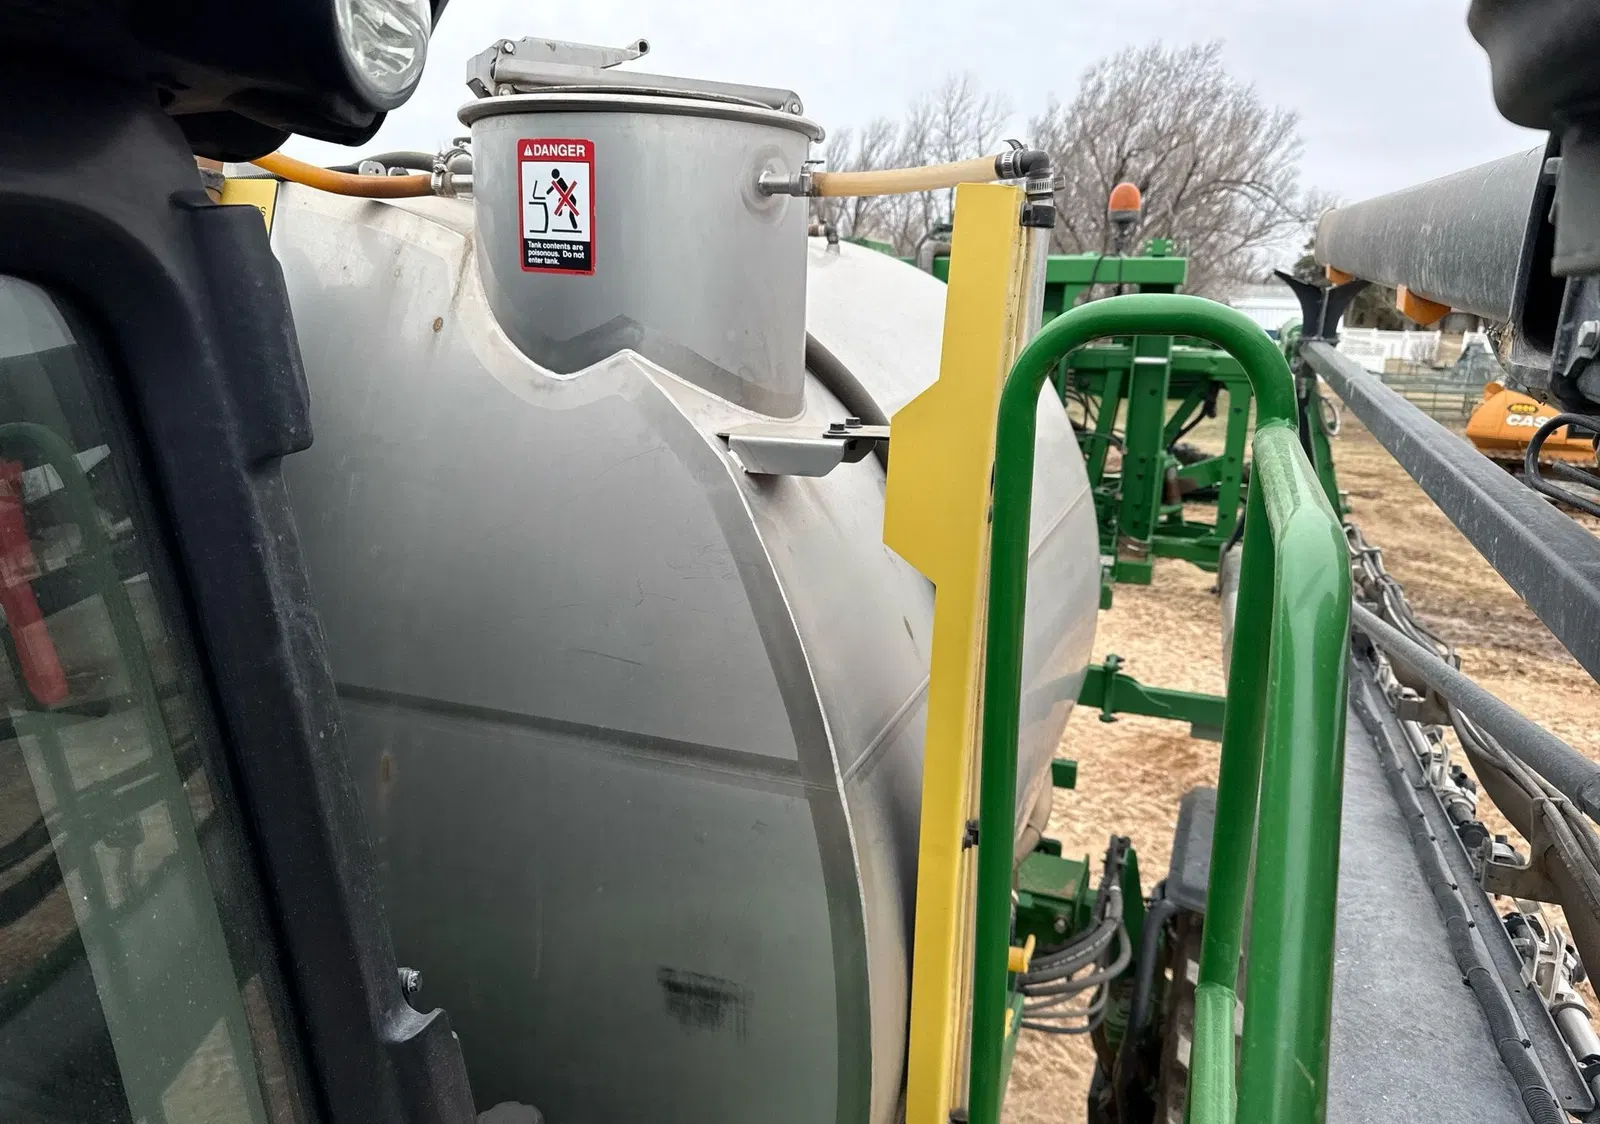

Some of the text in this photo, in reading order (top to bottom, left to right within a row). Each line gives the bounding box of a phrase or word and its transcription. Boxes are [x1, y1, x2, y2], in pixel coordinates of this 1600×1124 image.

[533, 144, 586, 157] DANGER
[528, 249, 560, 257] poisonous.
[544, 257, 560, 265] tank.
[1506, 414, 1551, 428] CAS
